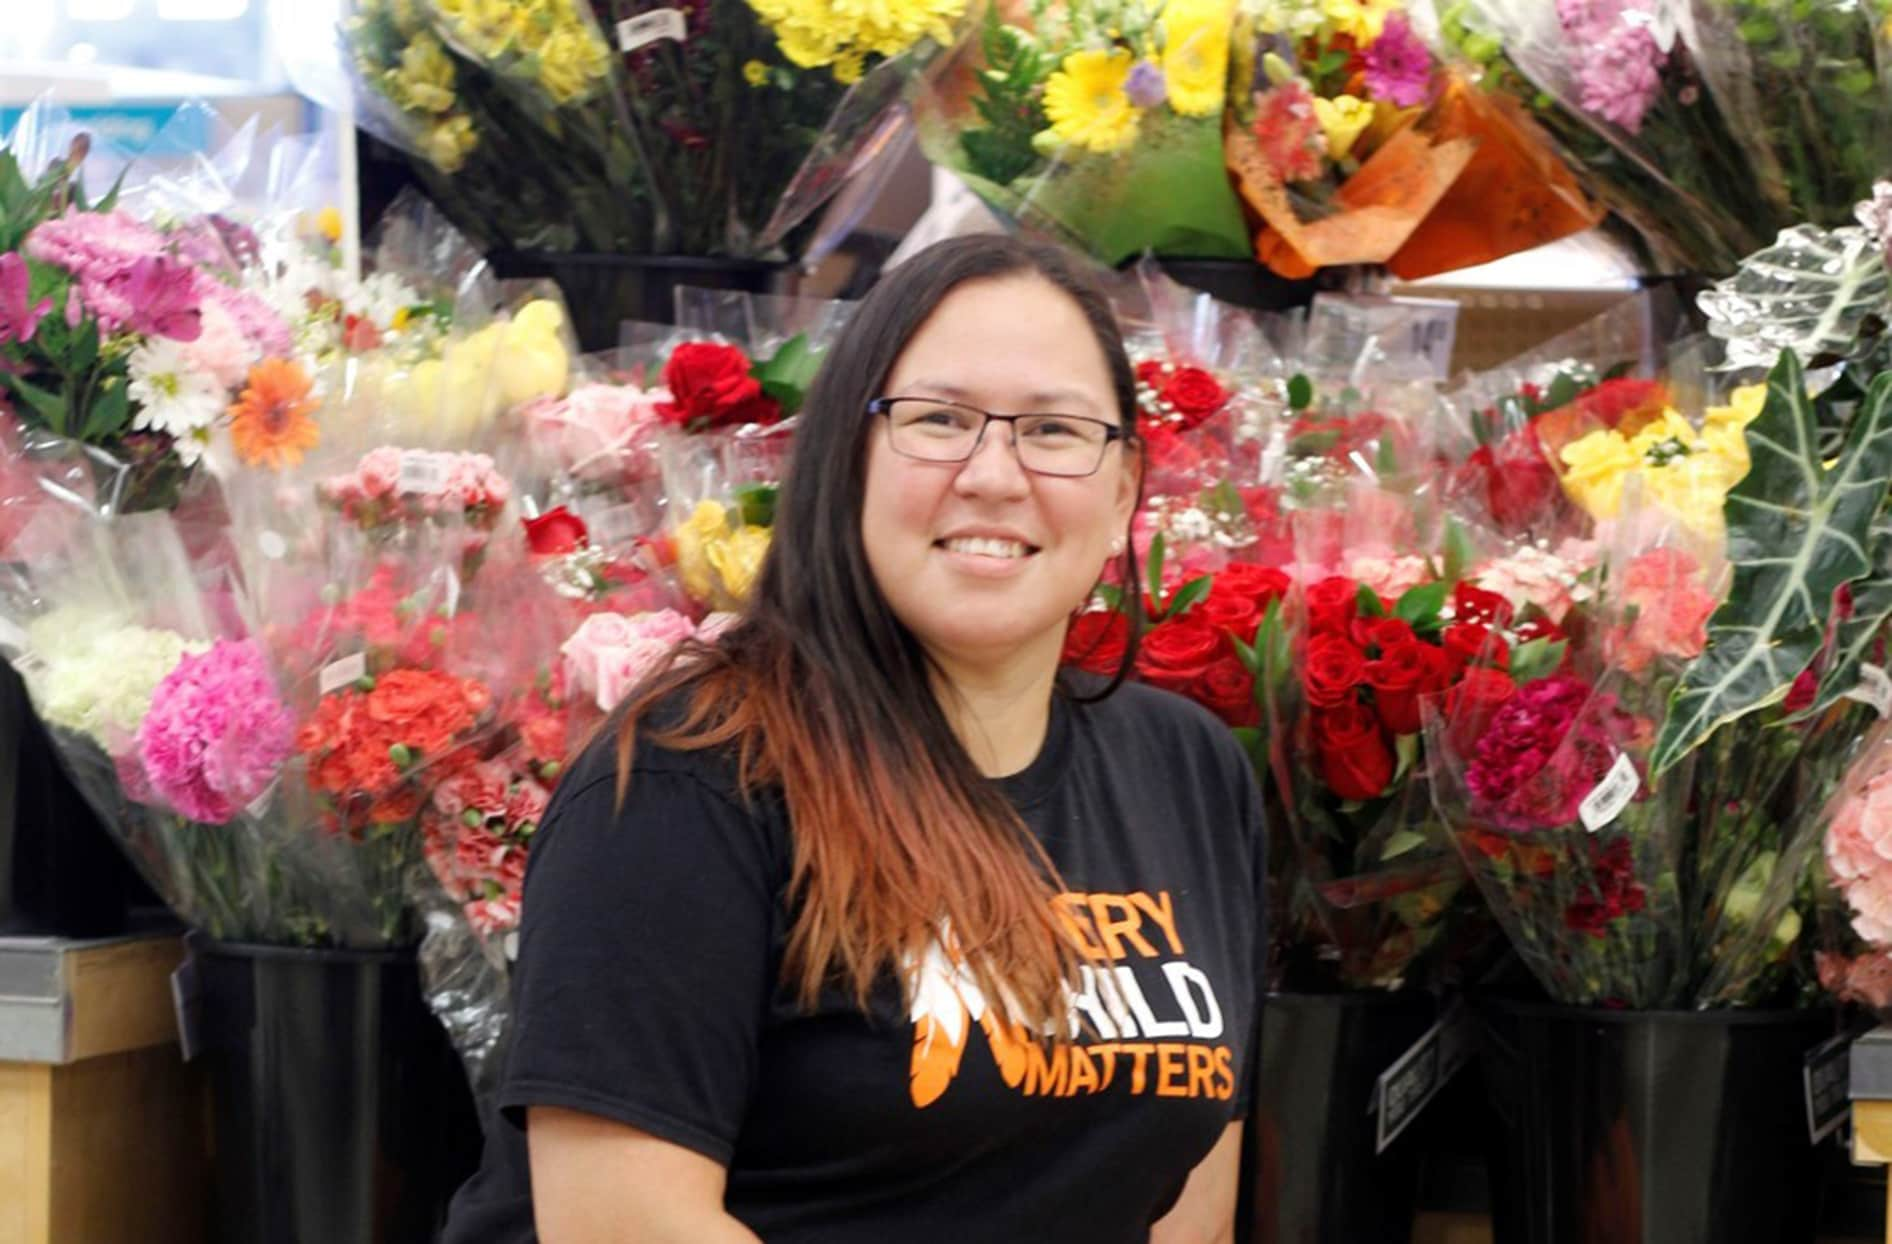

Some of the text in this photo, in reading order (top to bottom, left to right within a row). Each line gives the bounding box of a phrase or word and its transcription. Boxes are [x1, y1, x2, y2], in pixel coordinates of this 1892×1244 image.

[1050, 891, 1184, 959] ERY
[1045, 961, 1224, 1039] HILD
[1023, 1043, 1234, 1100] MATTERS
